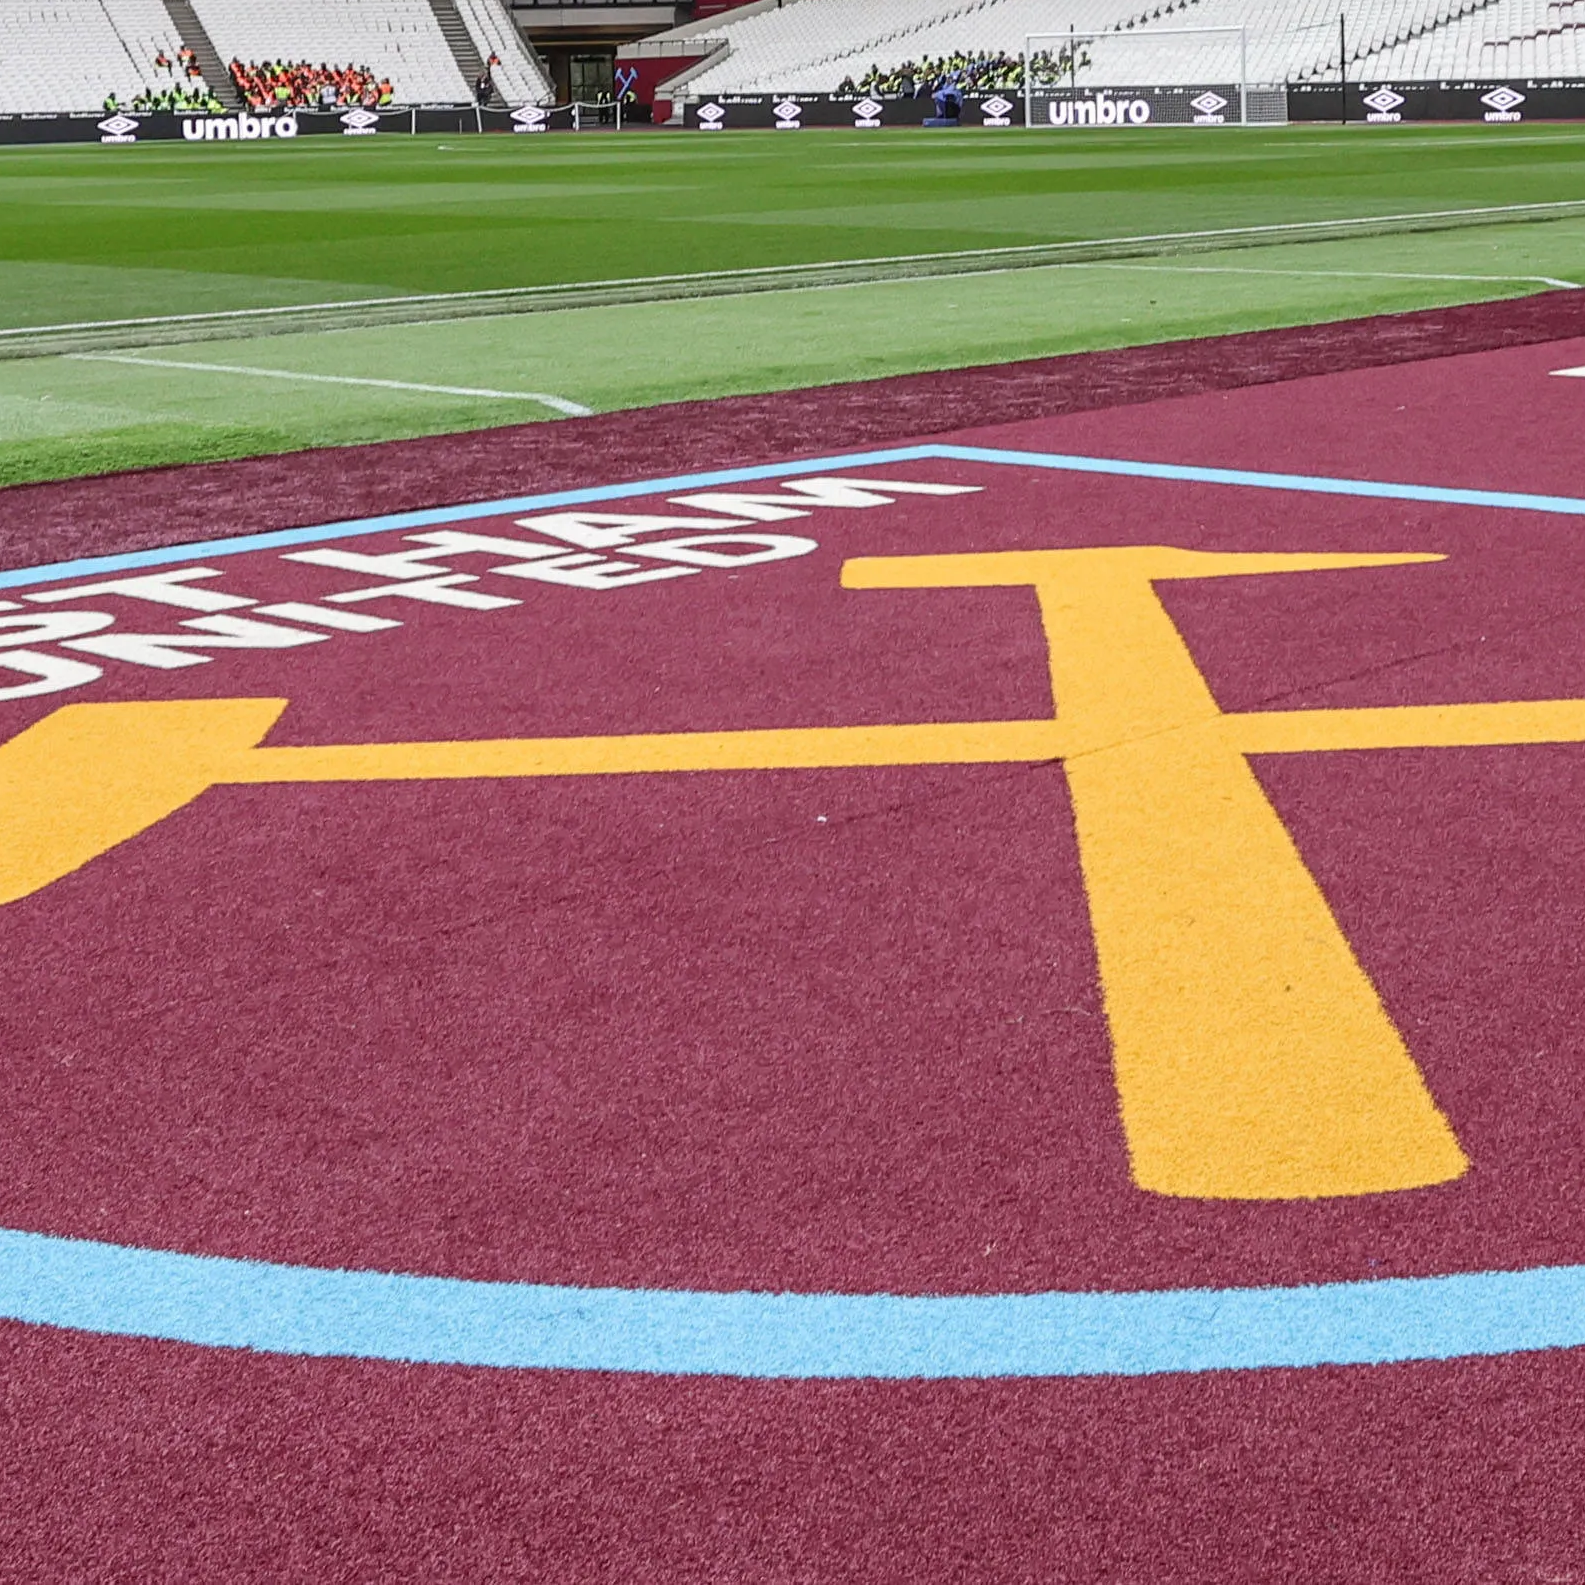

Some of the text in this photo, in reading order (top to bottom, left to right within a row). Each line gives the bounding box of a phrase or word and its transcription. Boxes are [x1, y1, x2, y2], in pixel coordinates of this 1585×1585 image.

[1050, 93, 1151, 125] umbro
[983, 116, 1011, 126] umbro
[1366, 111, 1401, 122] umbro
[1484, 110, 1521, 121] umbro
[182, 112, 298, 141] umbro
[101, 134, 136, 143] umbro
[280, 477, 985, 580] HAM
